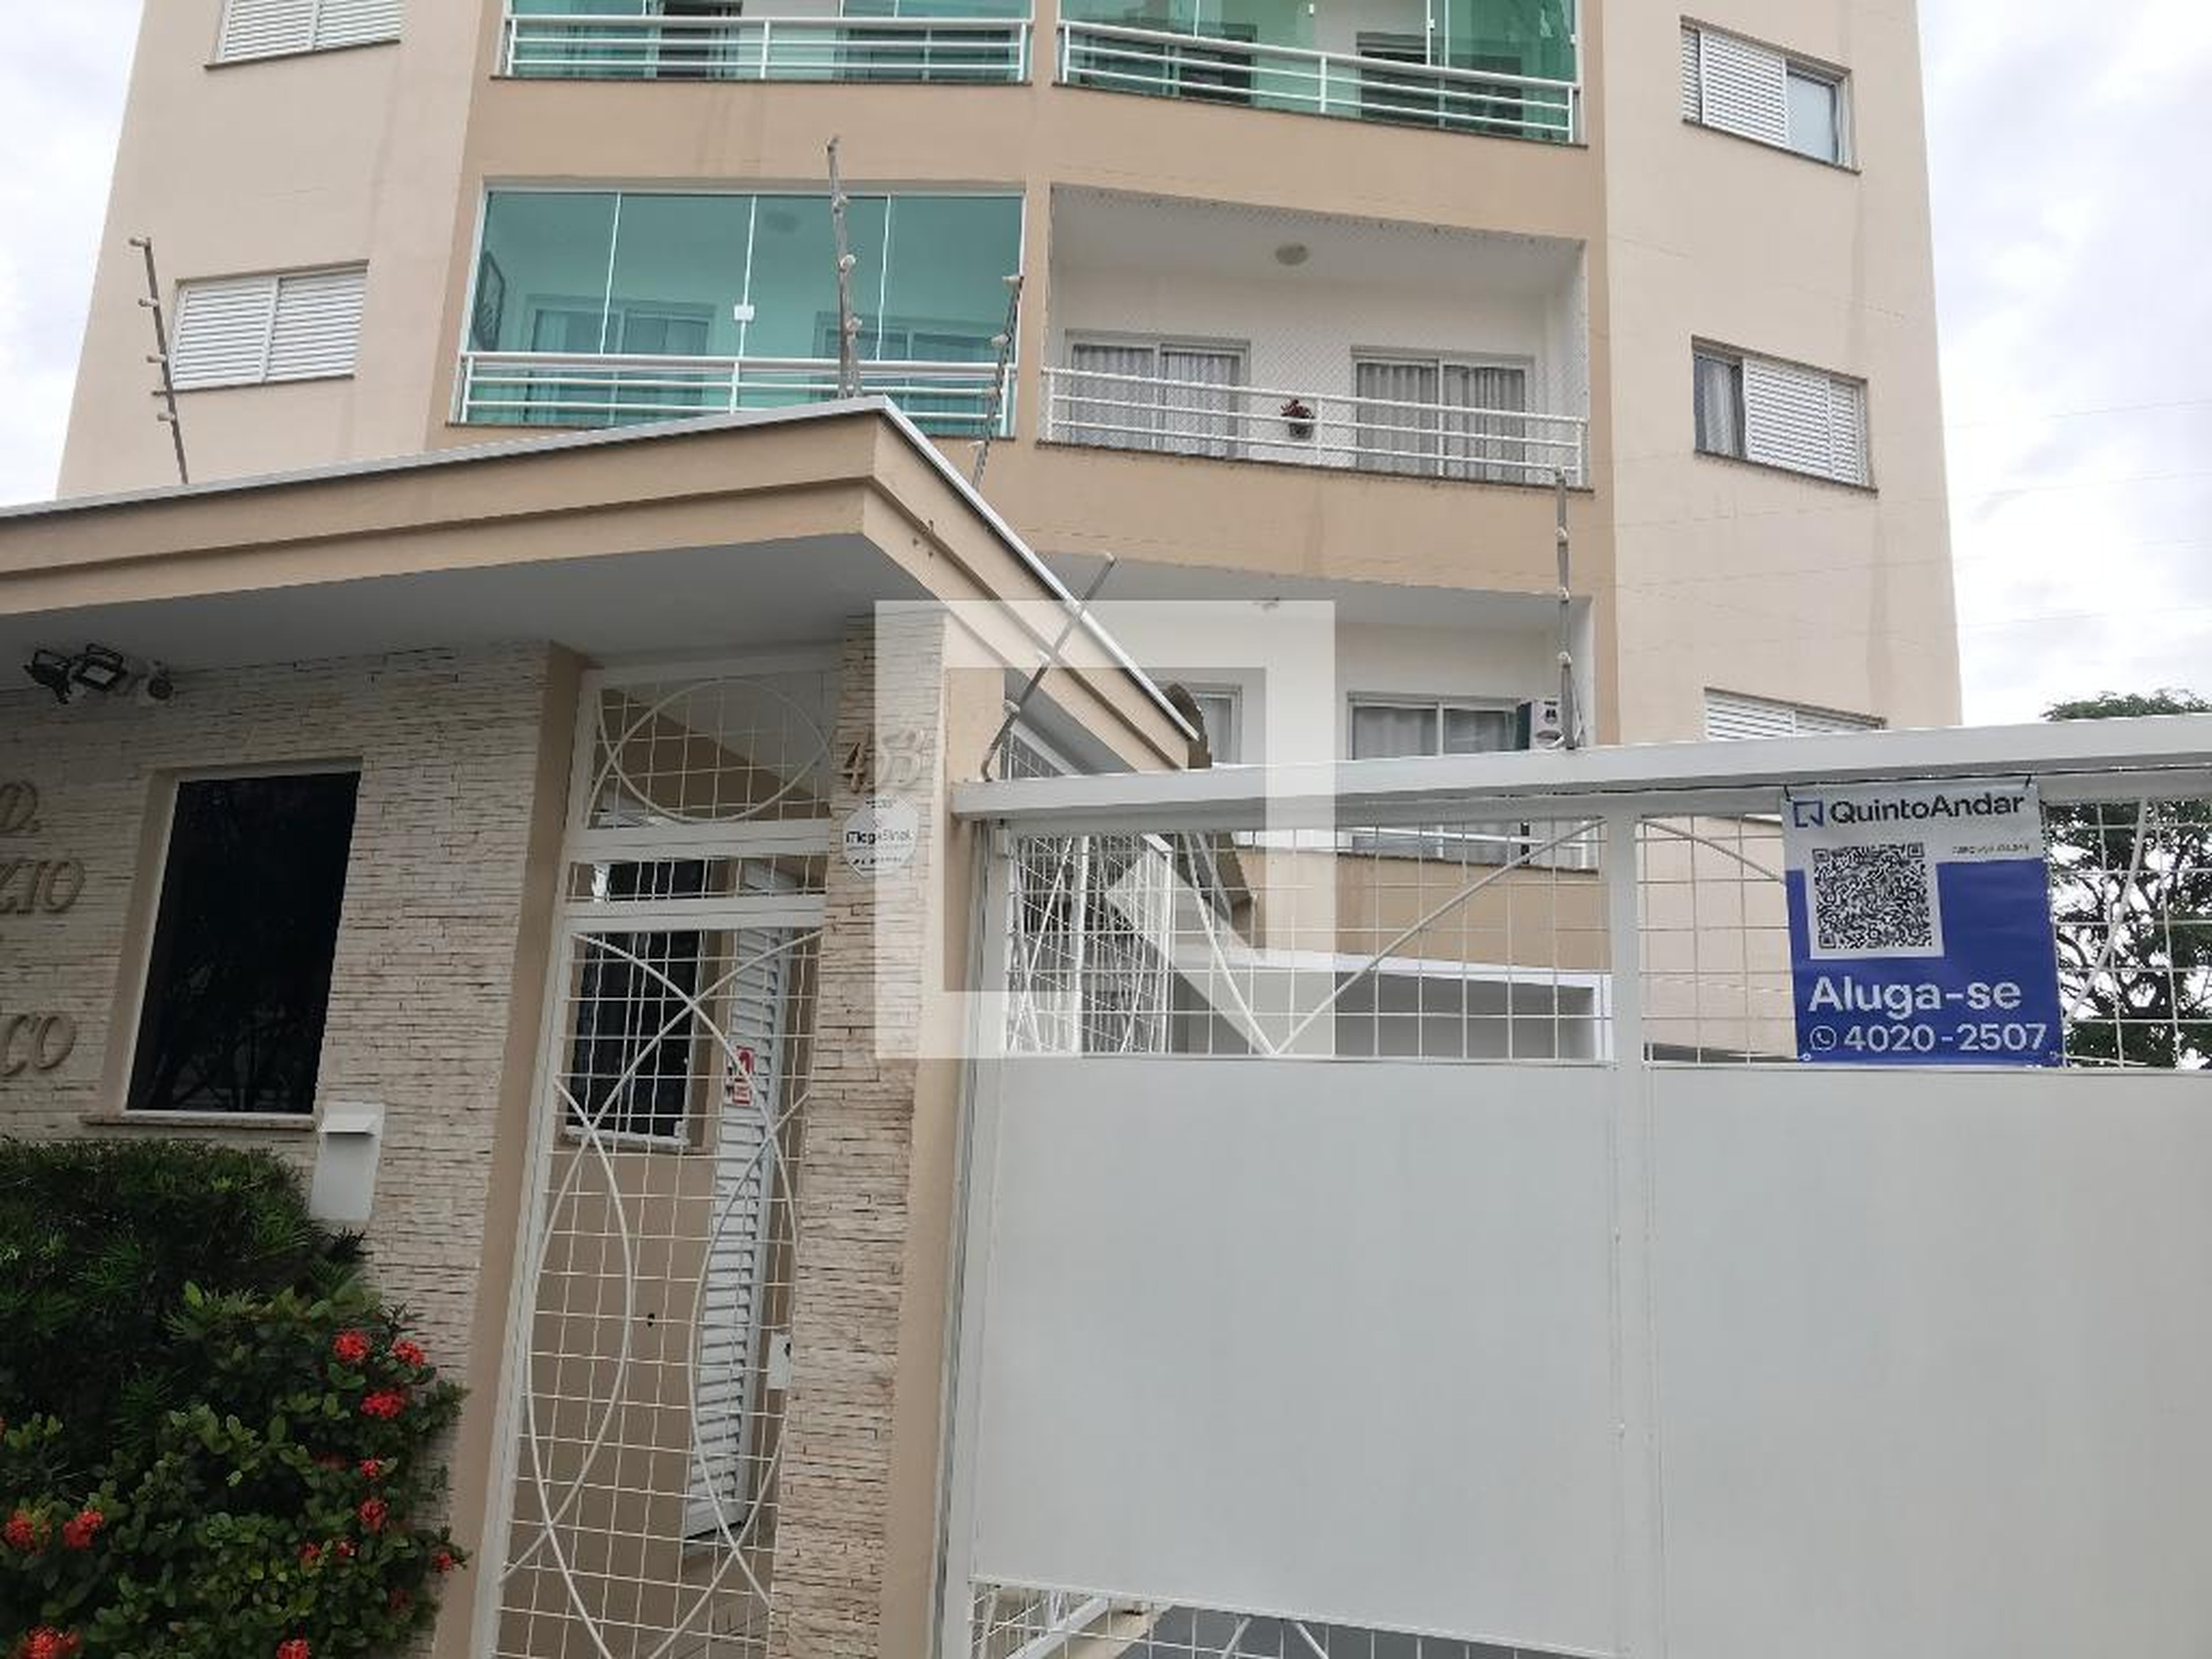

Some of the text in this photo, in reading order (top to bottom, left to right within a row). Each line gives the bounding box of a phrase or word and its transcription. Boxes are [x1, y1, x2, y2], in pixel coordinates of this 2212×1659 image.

[1830, 791, 2025, 824] QuintoAndar
[1808, 975, 2022, 1021] Aluga-se
[1844, 1022, 2048, 1052] 4020-2507
